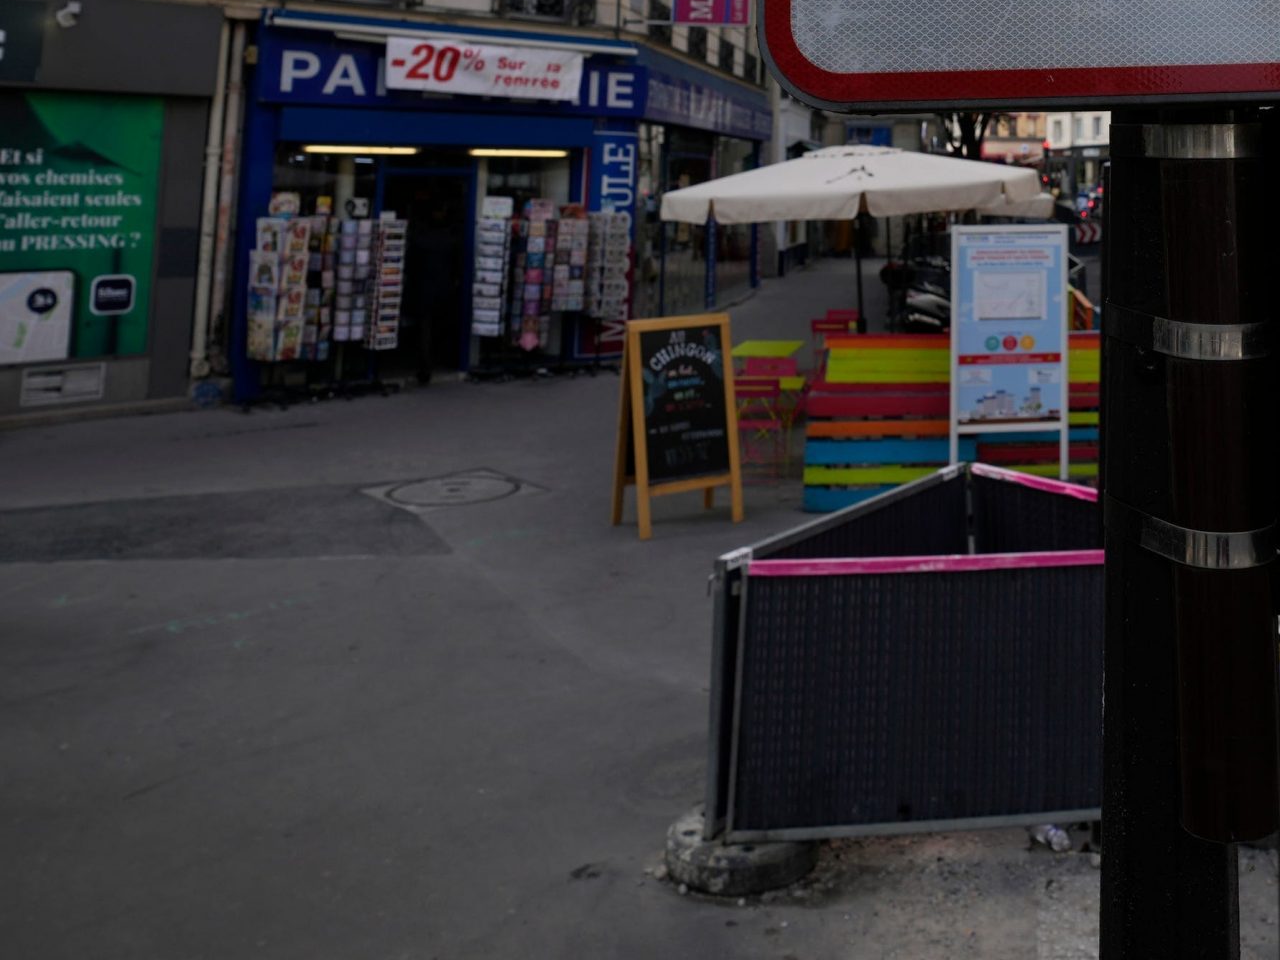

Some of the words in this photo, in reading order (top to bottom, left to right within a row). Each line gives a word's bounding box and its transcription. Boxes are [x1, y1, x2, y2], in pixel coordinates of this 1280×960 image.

[391, 44, 485, 82] -20%
[25, 148, 44, 165] si
[34, 168, 124, 185] chemises
[84, 190, 142, 207] seules
[21, 233, 125, 251] PRESSING
[650, 342, 716, 372] CHINGON
